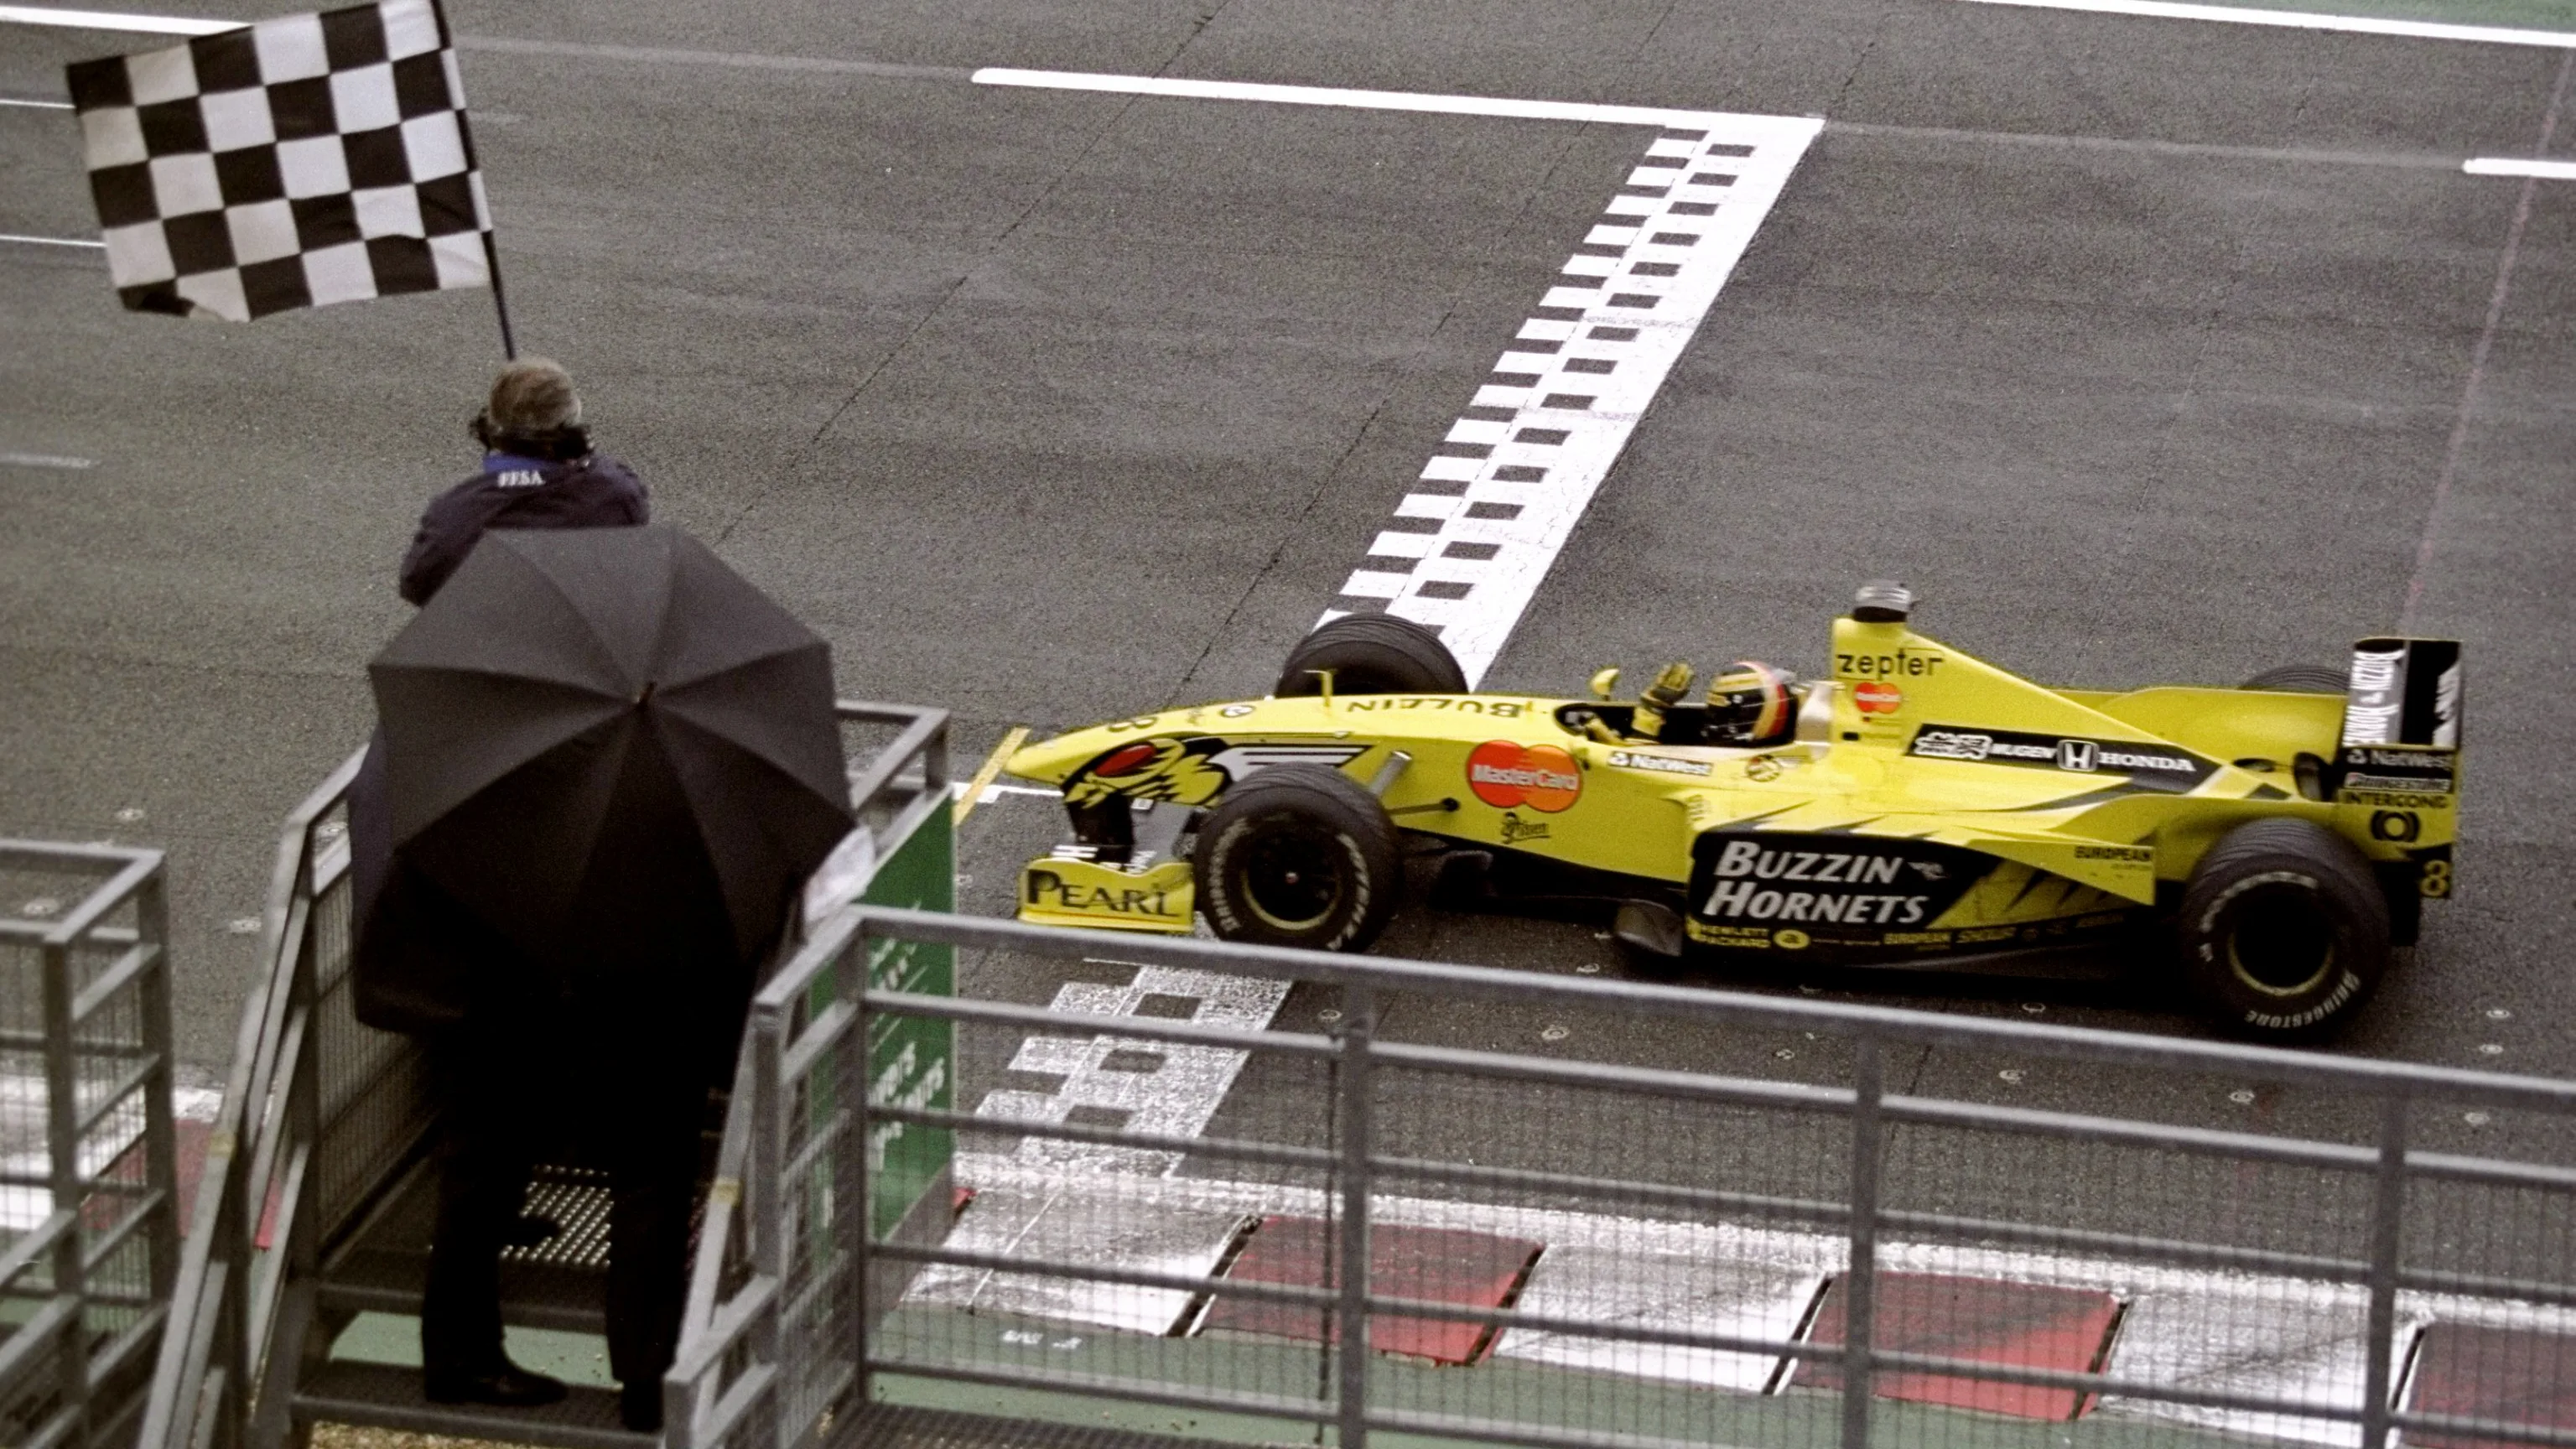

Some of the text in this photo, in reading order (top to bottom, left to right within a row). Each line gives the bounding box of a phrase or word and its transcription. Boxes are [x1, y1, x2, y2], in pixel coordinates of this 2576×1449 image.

[1836, 647, 1944, 681] zepter
[1472, 763, 1579, 791] MasterCard
[2099, 752, 2197, 771] HONDA
[1714, 840, 1905, 884] BUZZIN
[2421, 860, 2449, 899] 8
[1027, 869, 1180, 917] PEARL
[1702, 880, 1929, 923] HORNETS
